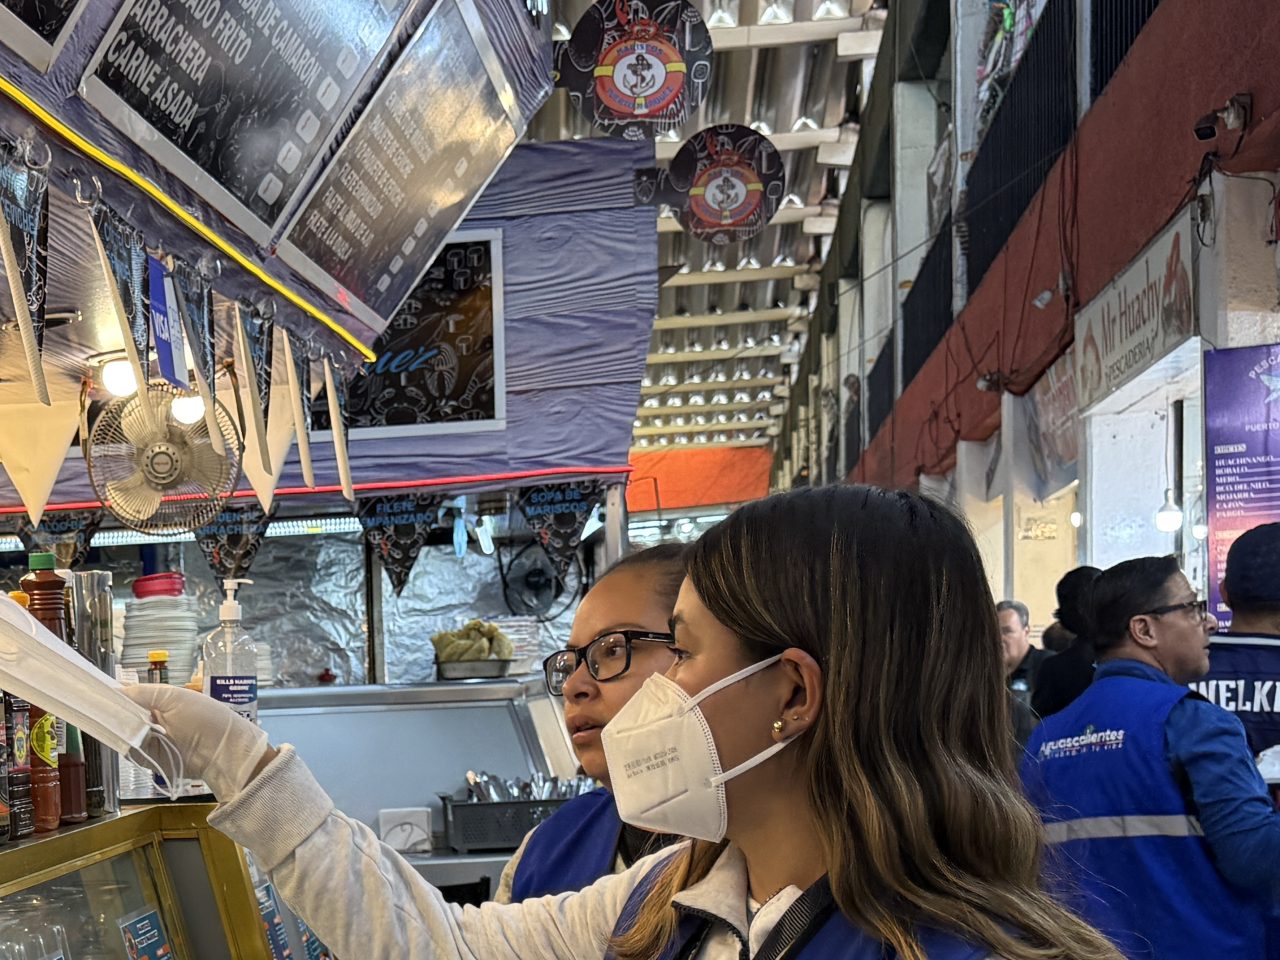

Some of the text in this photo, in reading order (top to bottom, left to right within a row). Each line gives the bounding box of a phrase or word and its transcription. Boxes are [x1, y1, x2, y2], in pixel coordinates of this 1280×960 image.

[256, 0, 282, 37] DE
[130, 0, 212, 86] ARRACHERA
[211, 10, 252, 65] FRITO
[107, 31, 199, 132] CARNE ASADA
[152, 308, 170, 344] VISA
[1245, 421, 1280, 432] PUERTO
[1215, 455, 1274, 467] HUACHINANGO
[526, 502, 588, 516] MARISCOS
[531, 489, 581, 503] SOPA DE
[1040, 727, 1125, 757] Aguascalientes
